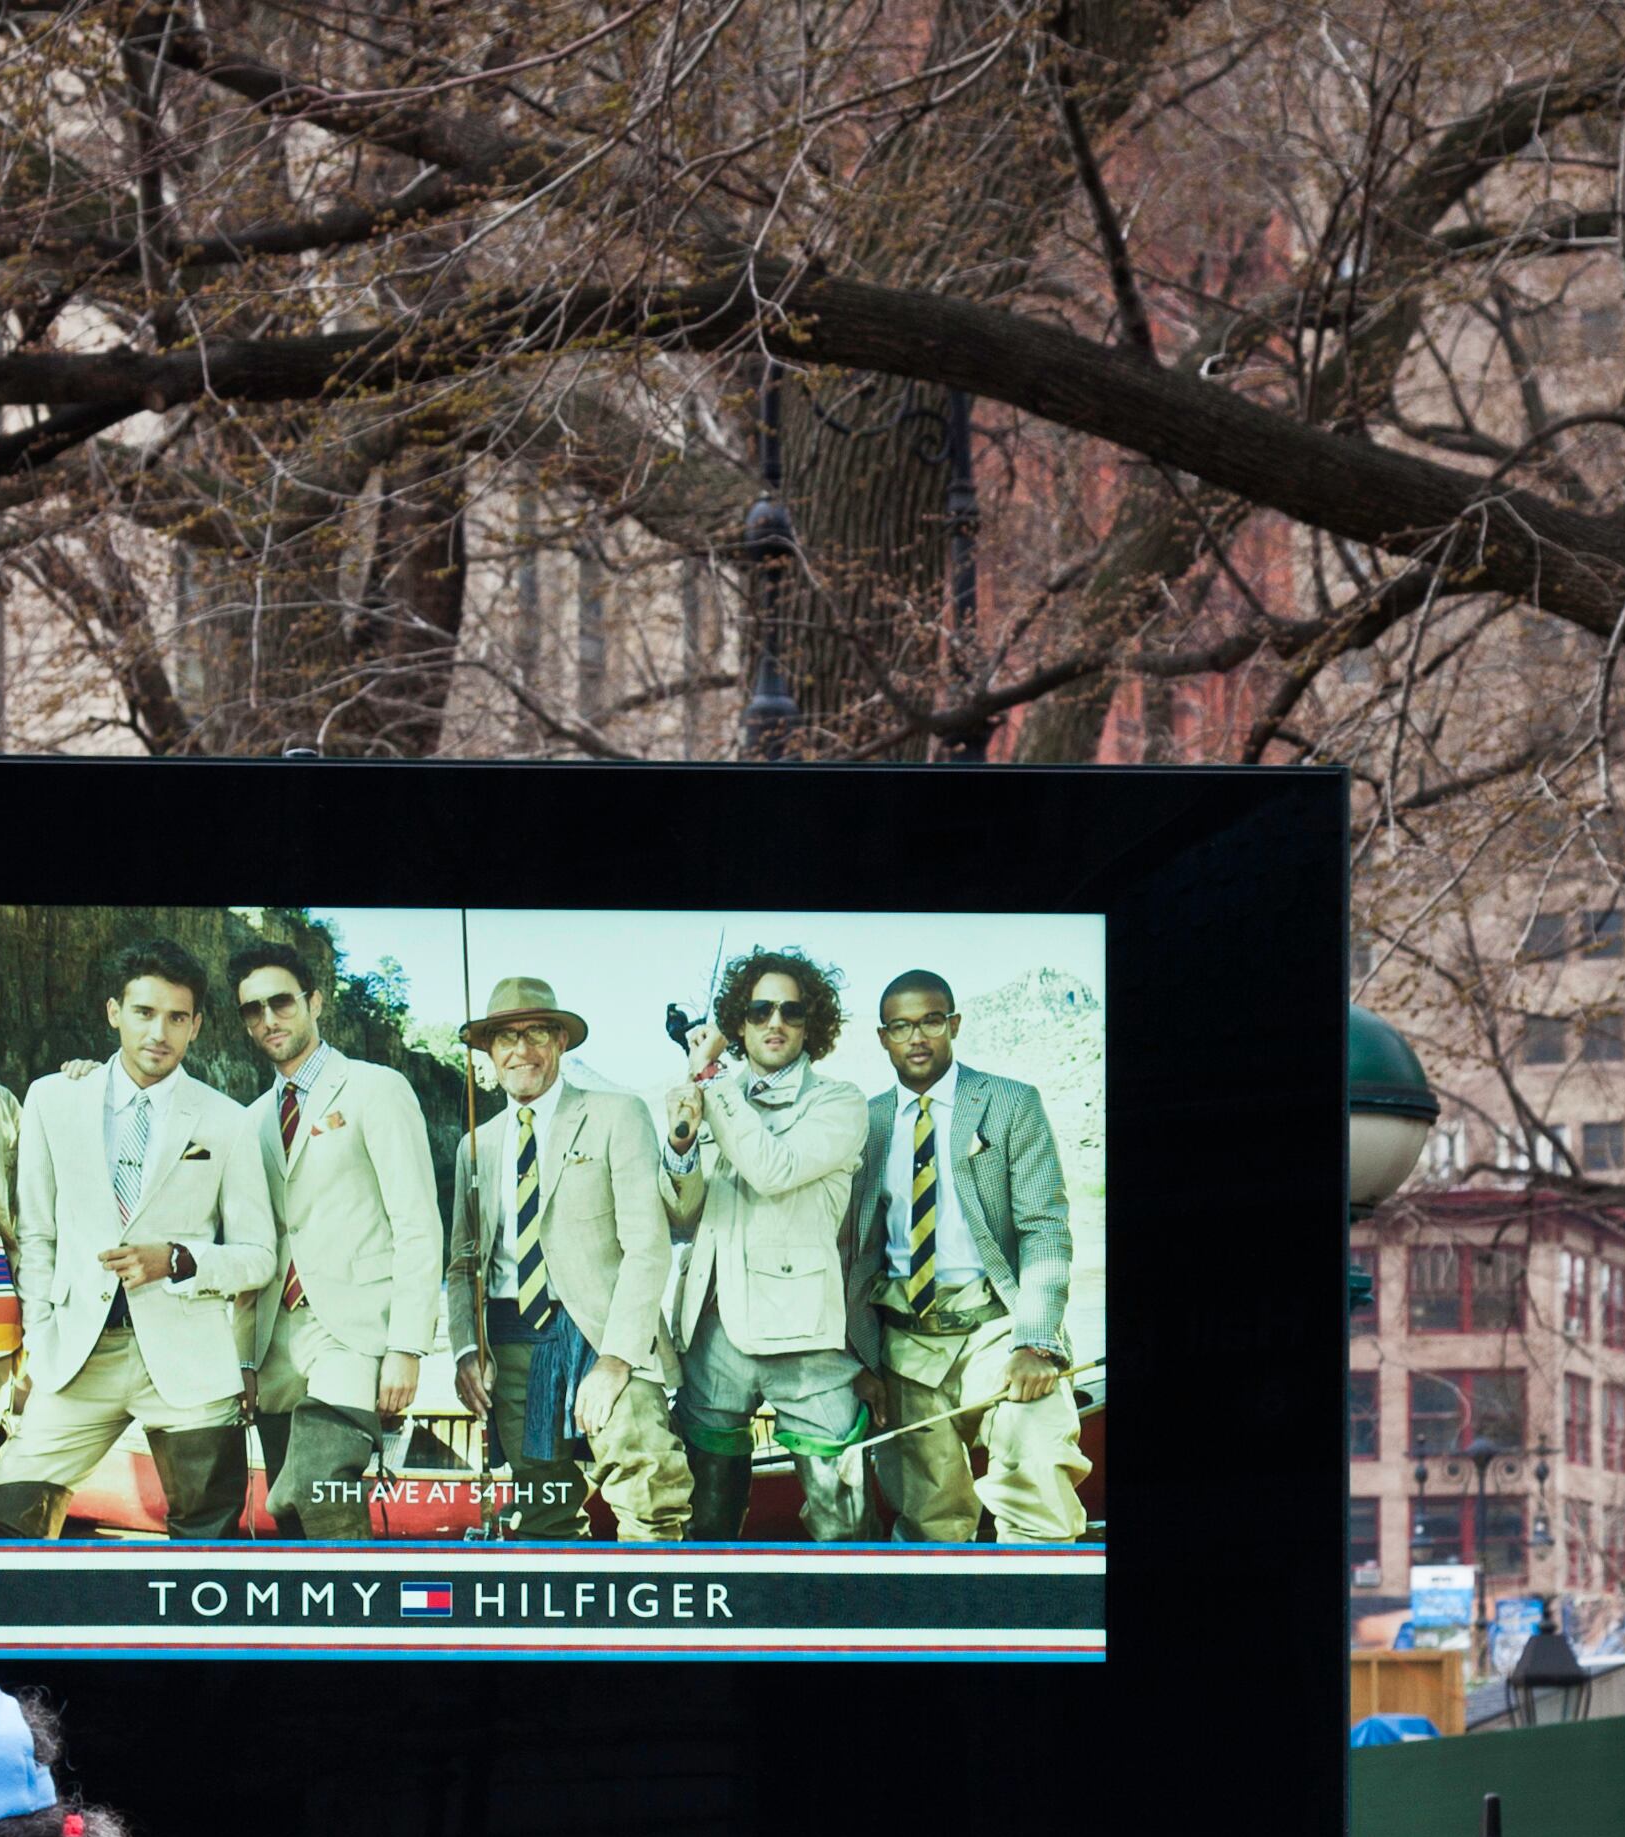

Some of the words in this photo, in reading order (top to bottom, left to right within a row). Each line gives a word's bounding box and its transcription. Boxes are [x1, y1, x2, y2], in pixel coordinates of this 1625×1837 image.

[311, 1481, 362, 1504] 5TH
[370, 1481, 419, 1504] AVE
[426, 1481, 461, 1504] AT
[469, 1481, 533, 1504] 54TH
[542, 1481, 573, 1504] ST
[149, 1581, 381, 1618] TOMMY
[475, 1582, 733, 1618] HILFIGER
